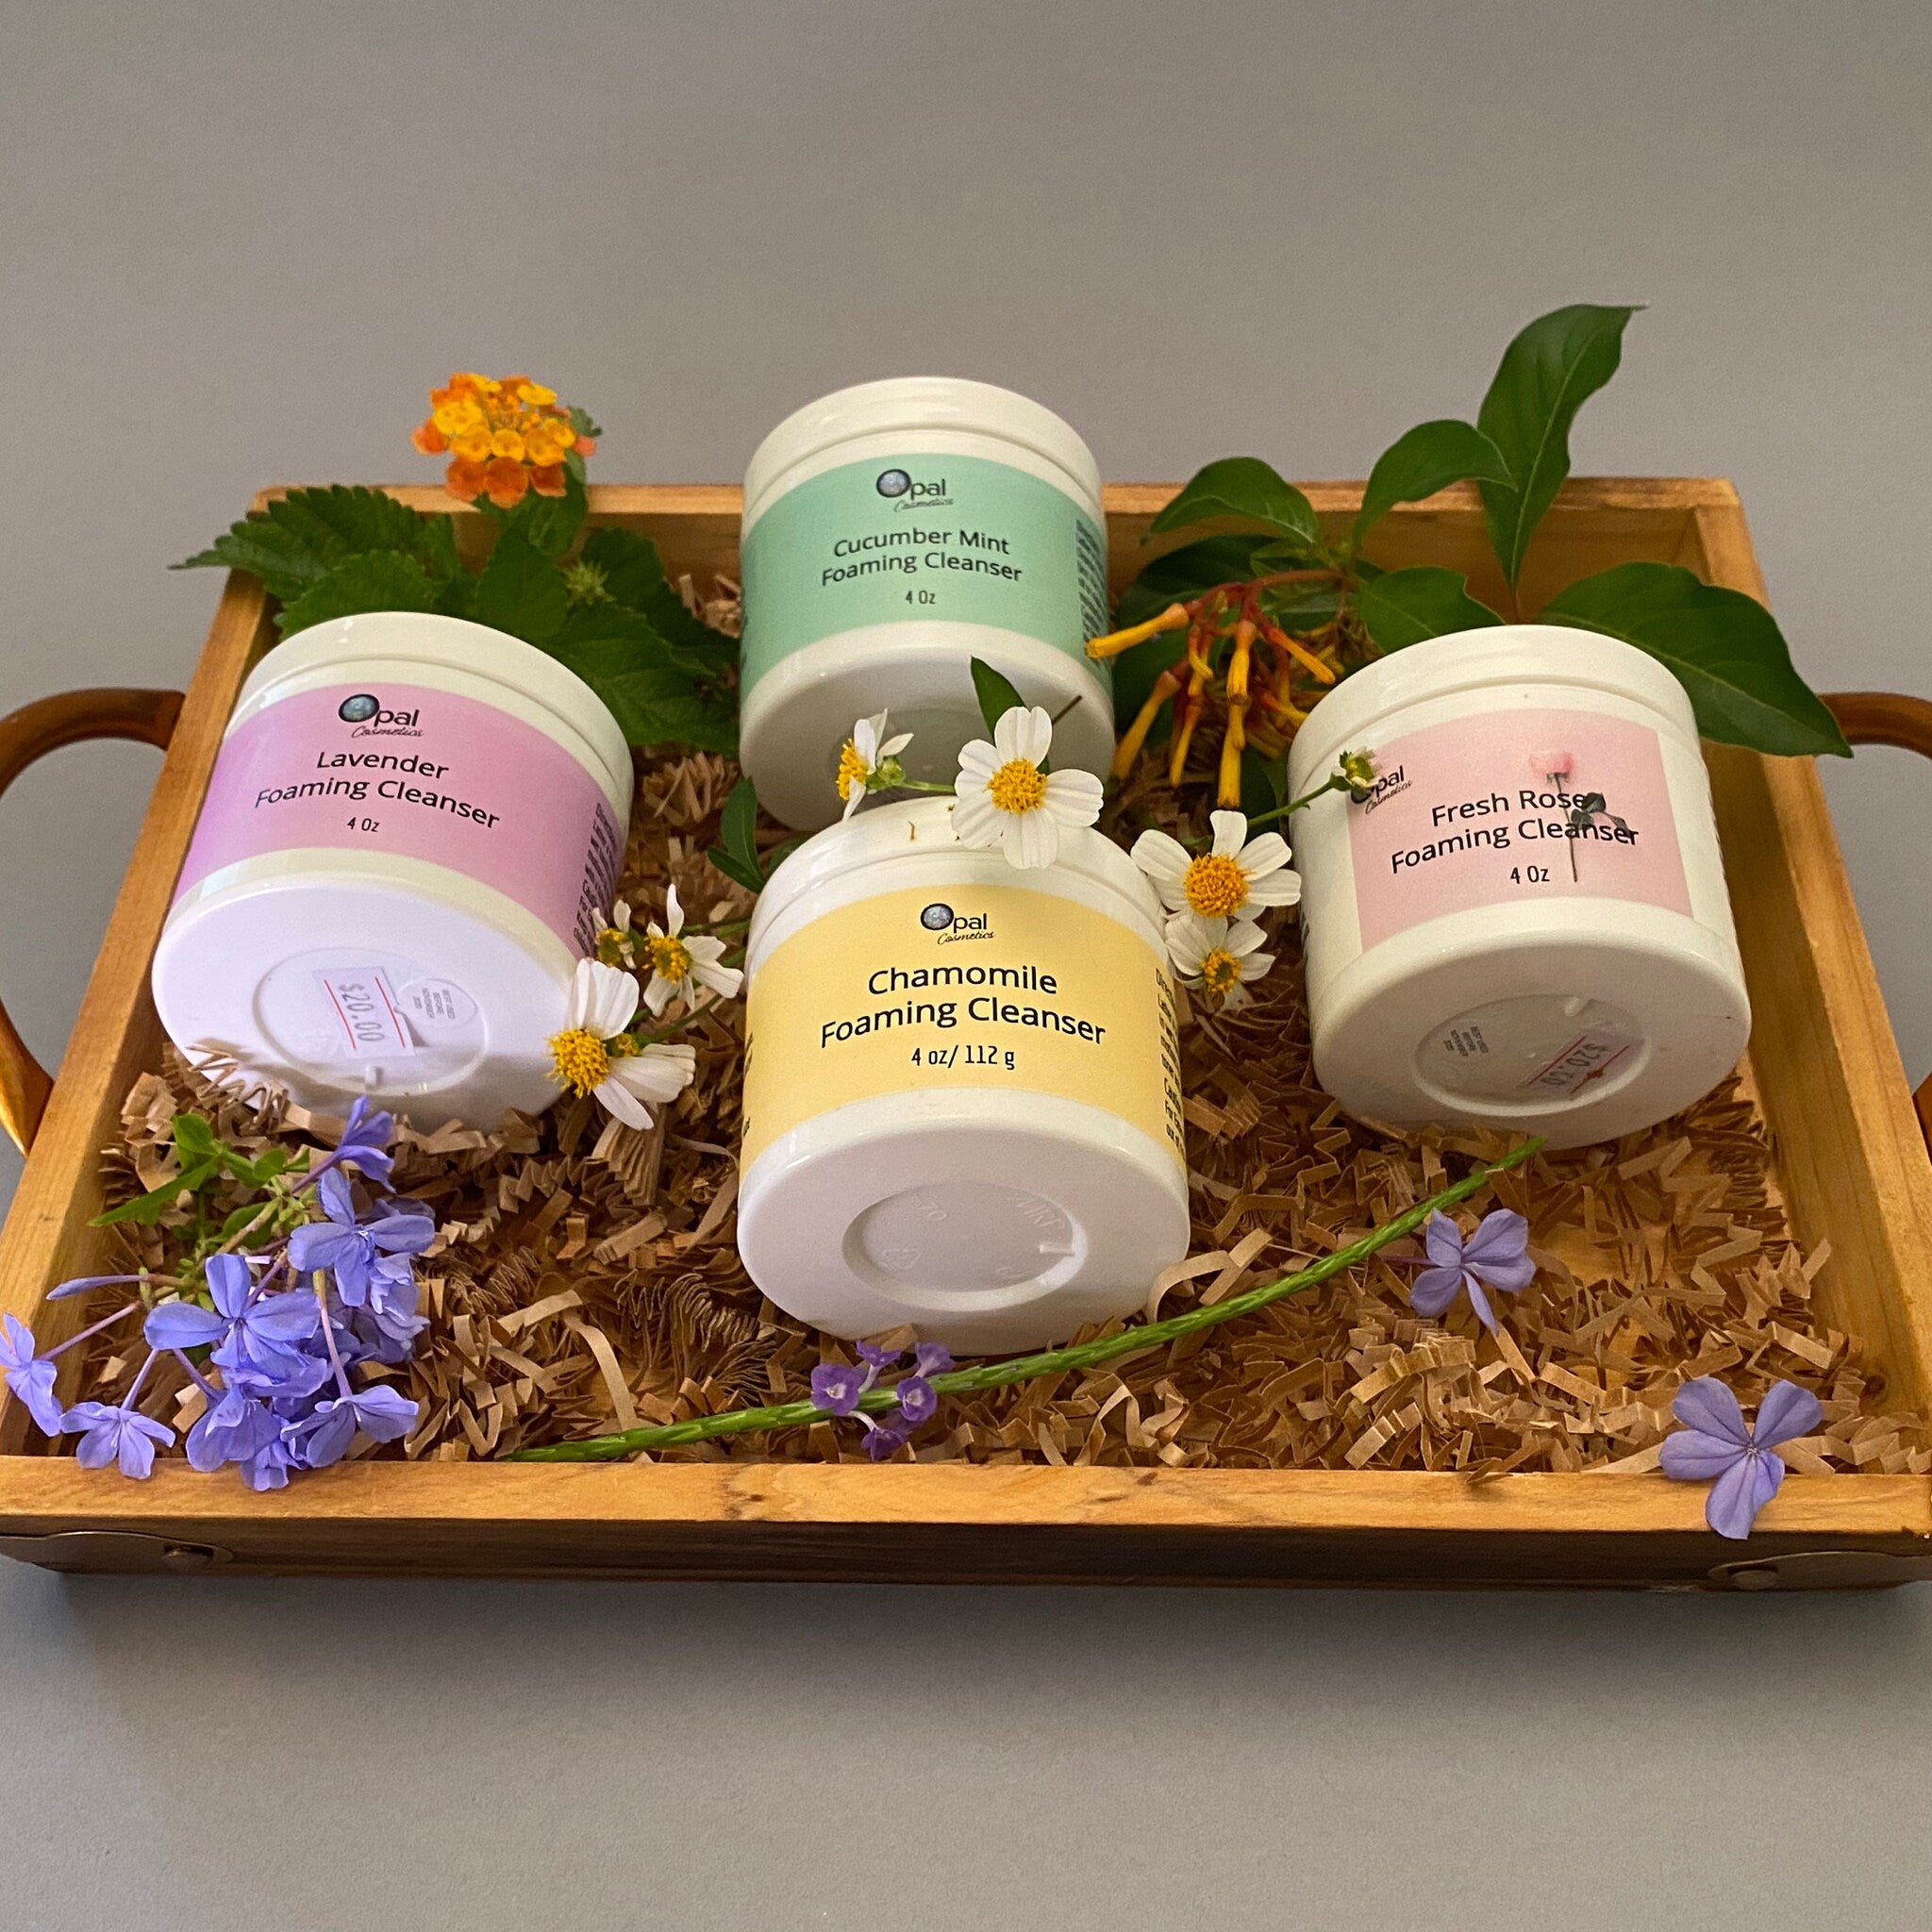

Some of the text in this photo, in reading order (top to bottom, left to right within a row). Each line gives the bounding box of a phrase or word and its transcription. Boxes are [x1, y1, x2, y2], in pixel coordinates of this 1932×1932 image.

[876, 468, 946, 500] Opal
[834, 527, 1010, 558] Cucumber Mint
[822, 552, 1023, 587] Foaming Cleanser
[906, 591, 936, 604] 4 Oz
[339, 693, 420, 726] Opal
[317, 752, 449, 779] Lavender
[255, 777, 500, 828] Foaming Cleanser
[1432, 790, 1589, 826] Fresh Rose
[347, 817, 380, 832] 4 Oz
[1391, 818, 1639, 874] Foaming Cleanser
[1510, 865, 1551, 884] 4 Oz
[921, 903, 987, 933] Opal
[937, 930, 995, 945] Cosmetics
[869, 965, 1057, 995] Chamomile
[339, 983, 385, 1041] $20.00
[822, 996, 1106, 1048] Foaming Cleanser
[911, 1044, 1015, 1071] 4 oz/ 112 g
